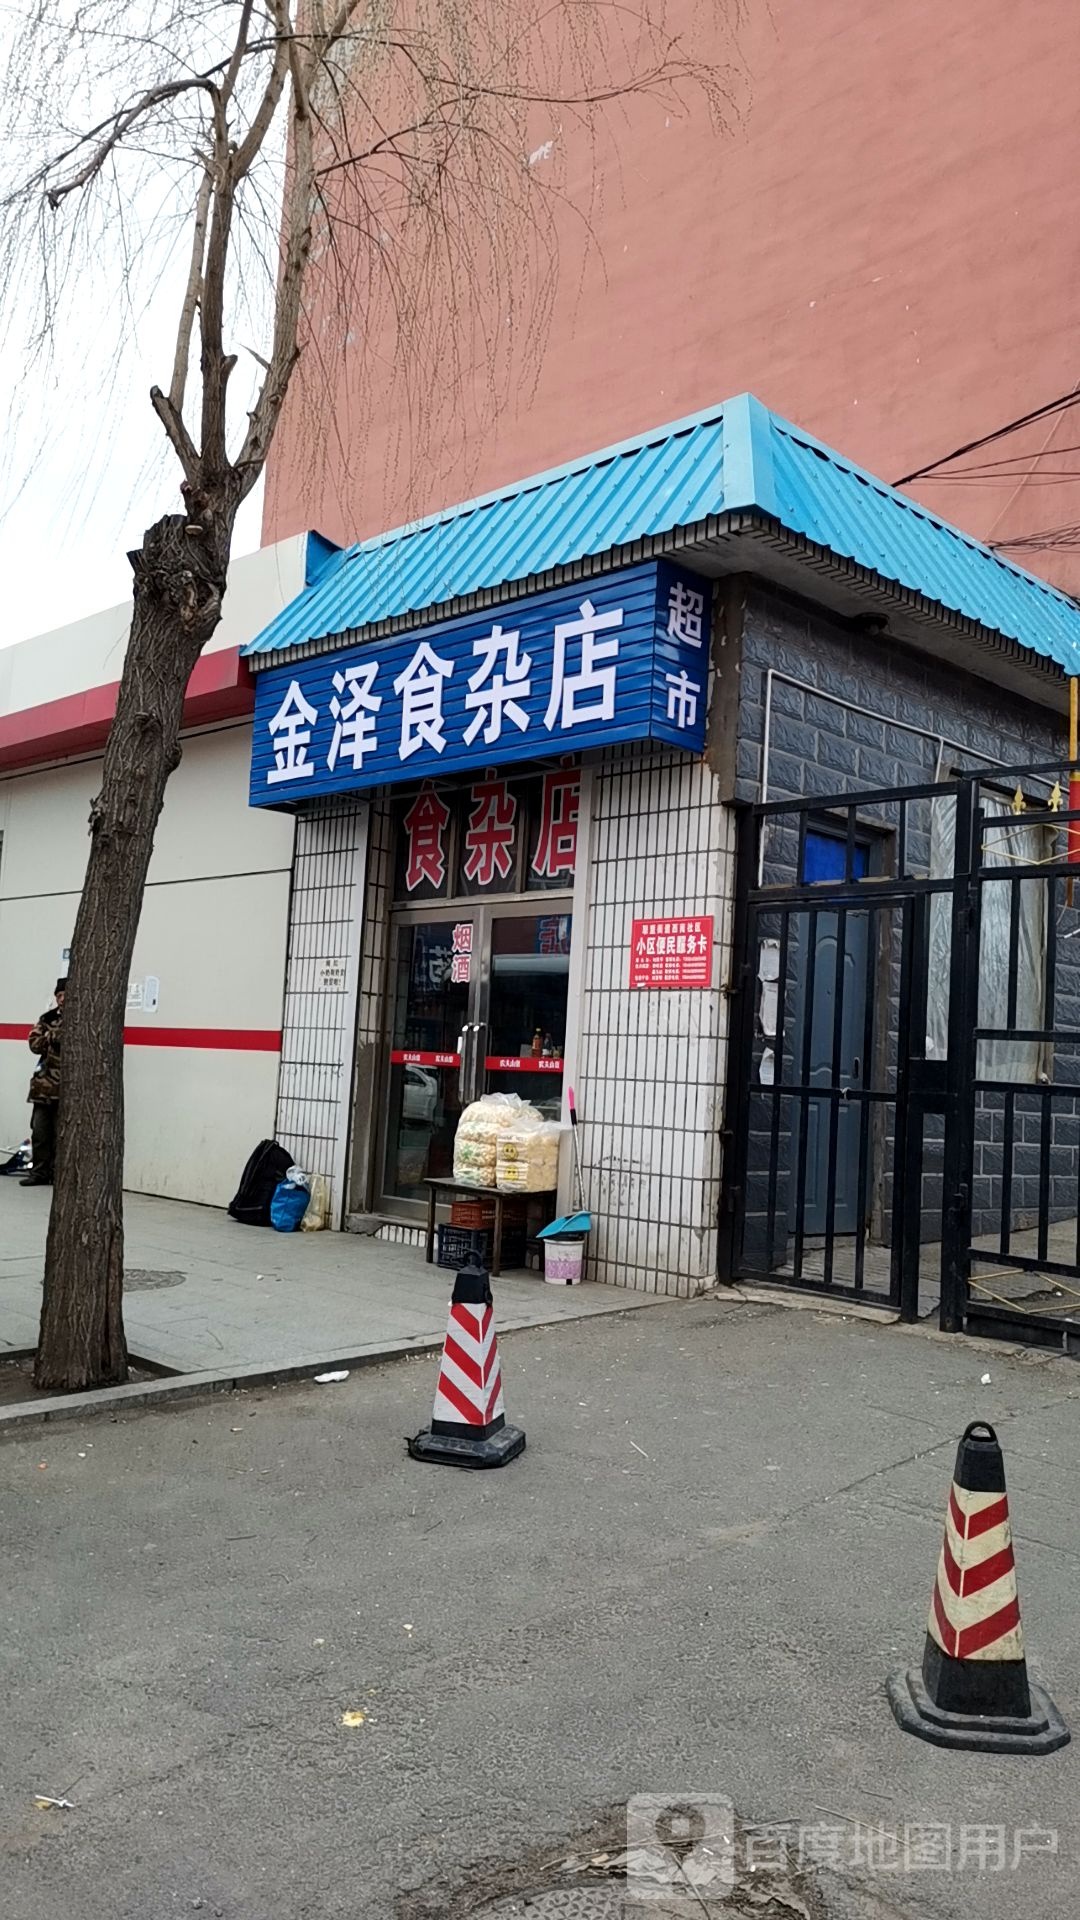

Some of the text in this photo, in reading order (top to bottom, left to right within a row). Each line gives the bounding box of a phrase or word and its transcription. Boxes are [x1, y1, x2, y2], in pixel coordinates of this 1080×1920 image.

[266, 599, 624, 784] 金泽食杂店
[665, 581, 705, 730] 超市
[403, 755, 581, 892] 食杂店
[450, 923, 474, 984] 烟酒
